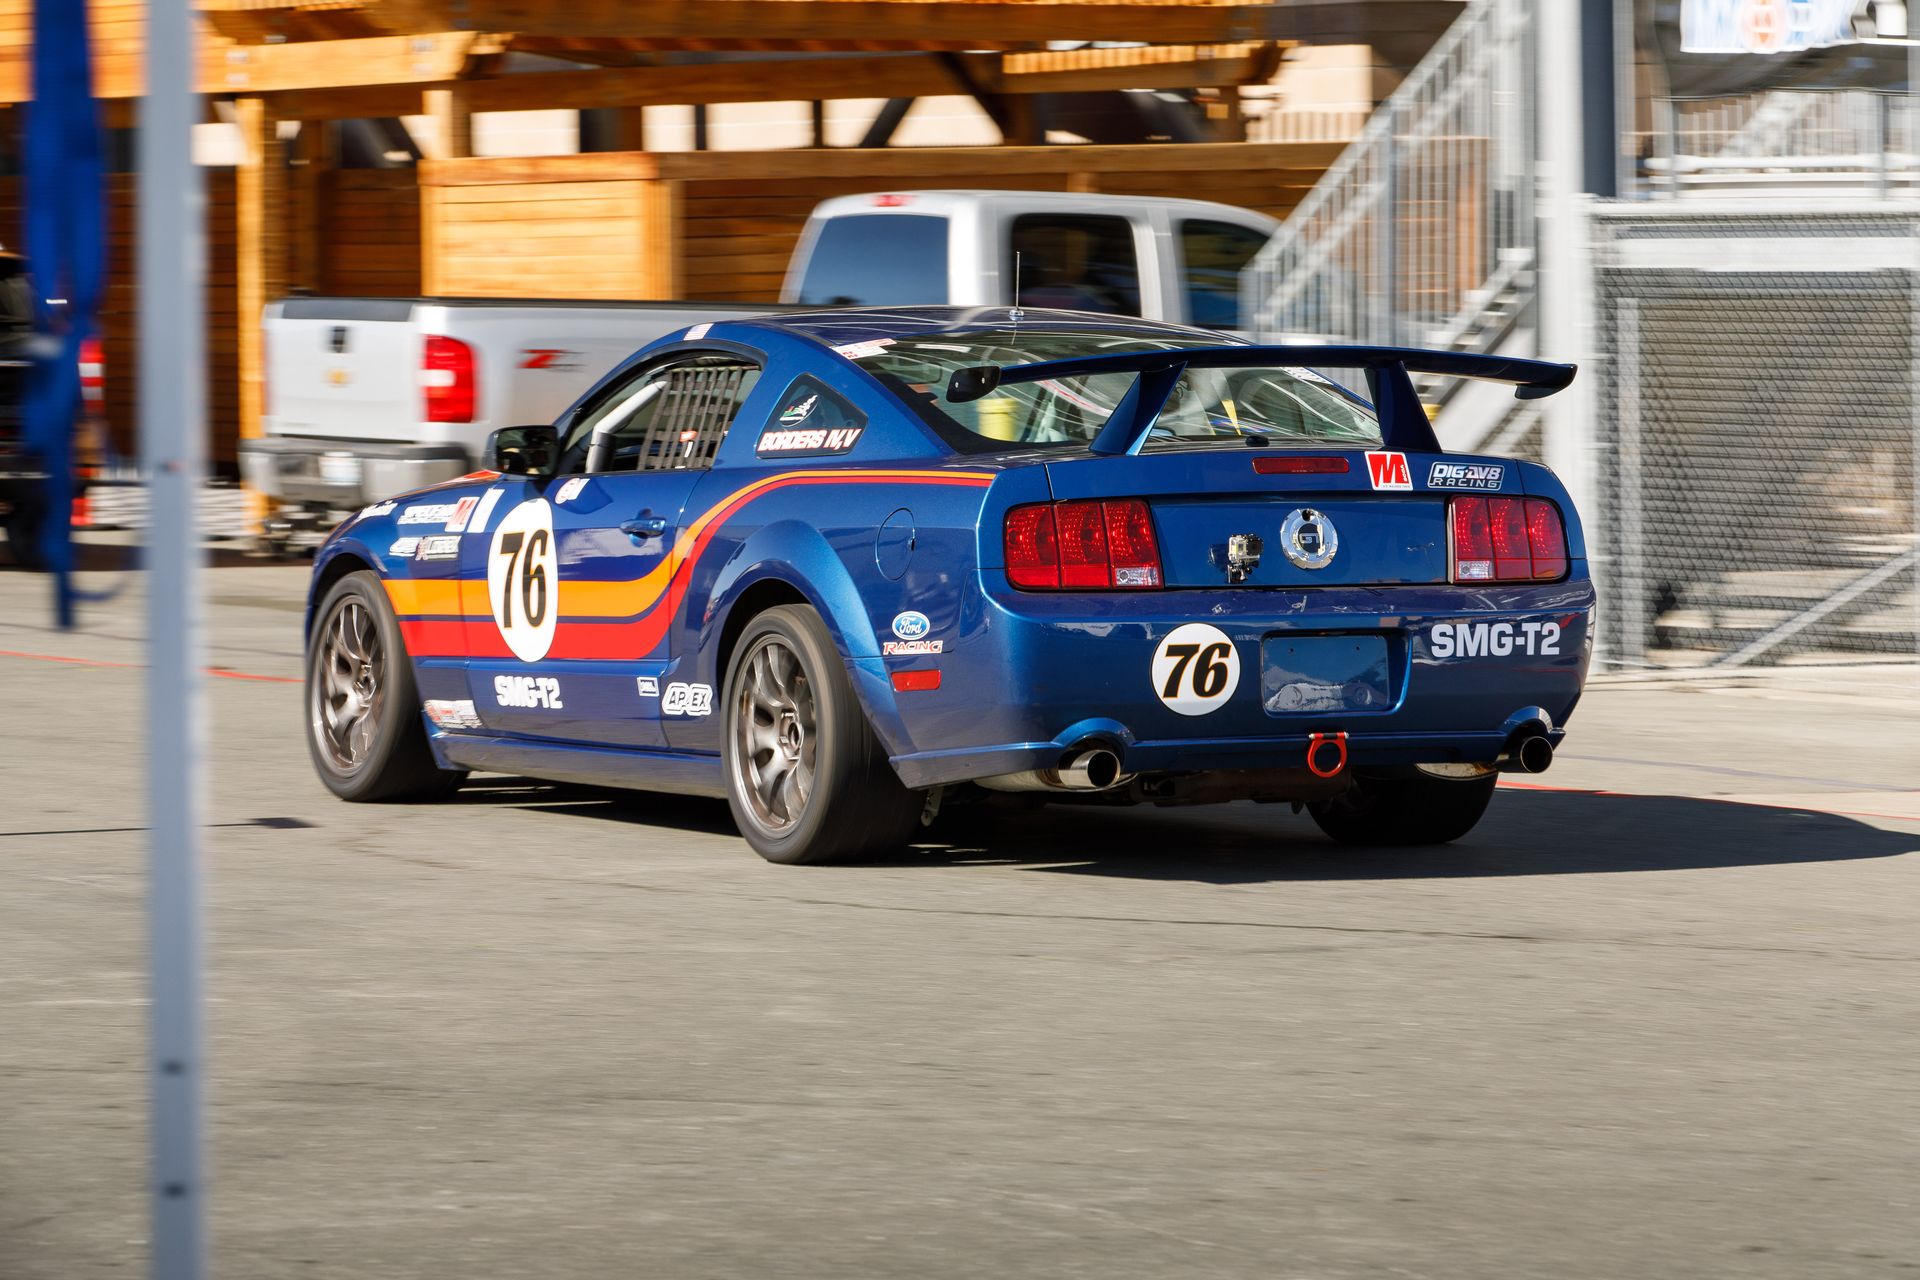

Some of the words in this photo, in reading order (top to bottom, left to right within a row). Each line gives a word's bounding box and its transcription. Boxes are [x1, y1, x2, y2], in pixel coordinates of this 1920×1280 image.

[1431, 478, 1498, 488] RACING
[499, 528, 550, 629] 76
[899, 616, 923, 634] Ford
[1431, 622, 1560, 658] SMG-T2
[883, 641, 943, 655] RACING
[1161, 642, 1233, 699] 76
[494, 675, 564, 709] SMG-T2
